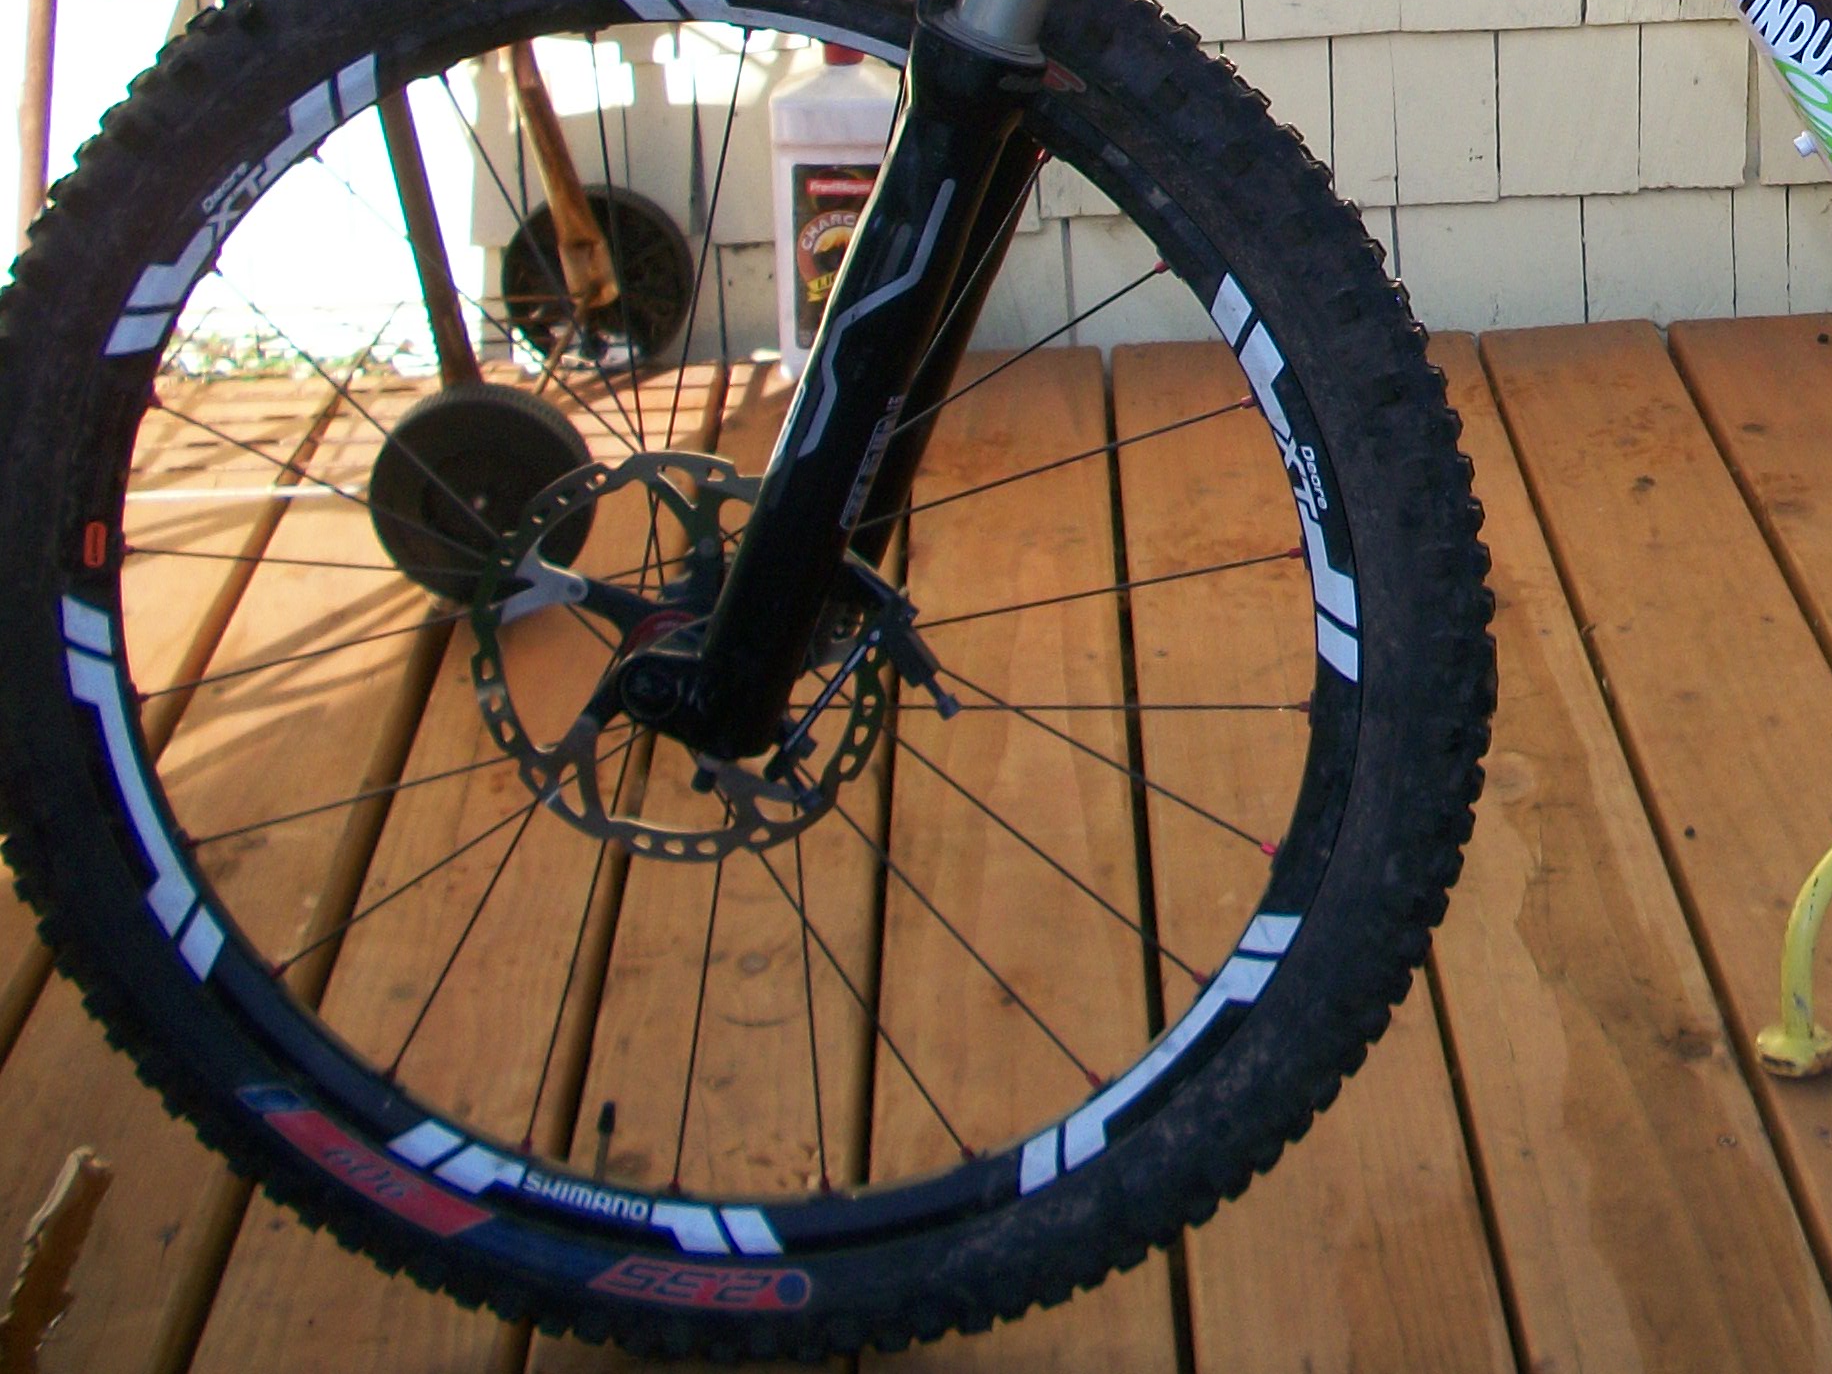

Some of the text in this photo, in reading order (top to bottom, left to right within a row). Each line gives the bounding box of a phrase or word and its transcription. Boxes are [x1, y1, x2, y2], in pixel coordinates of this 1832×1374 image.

[1273, 430, 1319, 520] XT
[1300, 444, 1327, 511] Deore
[522, 1171, 649, 1221] SHIMANO
